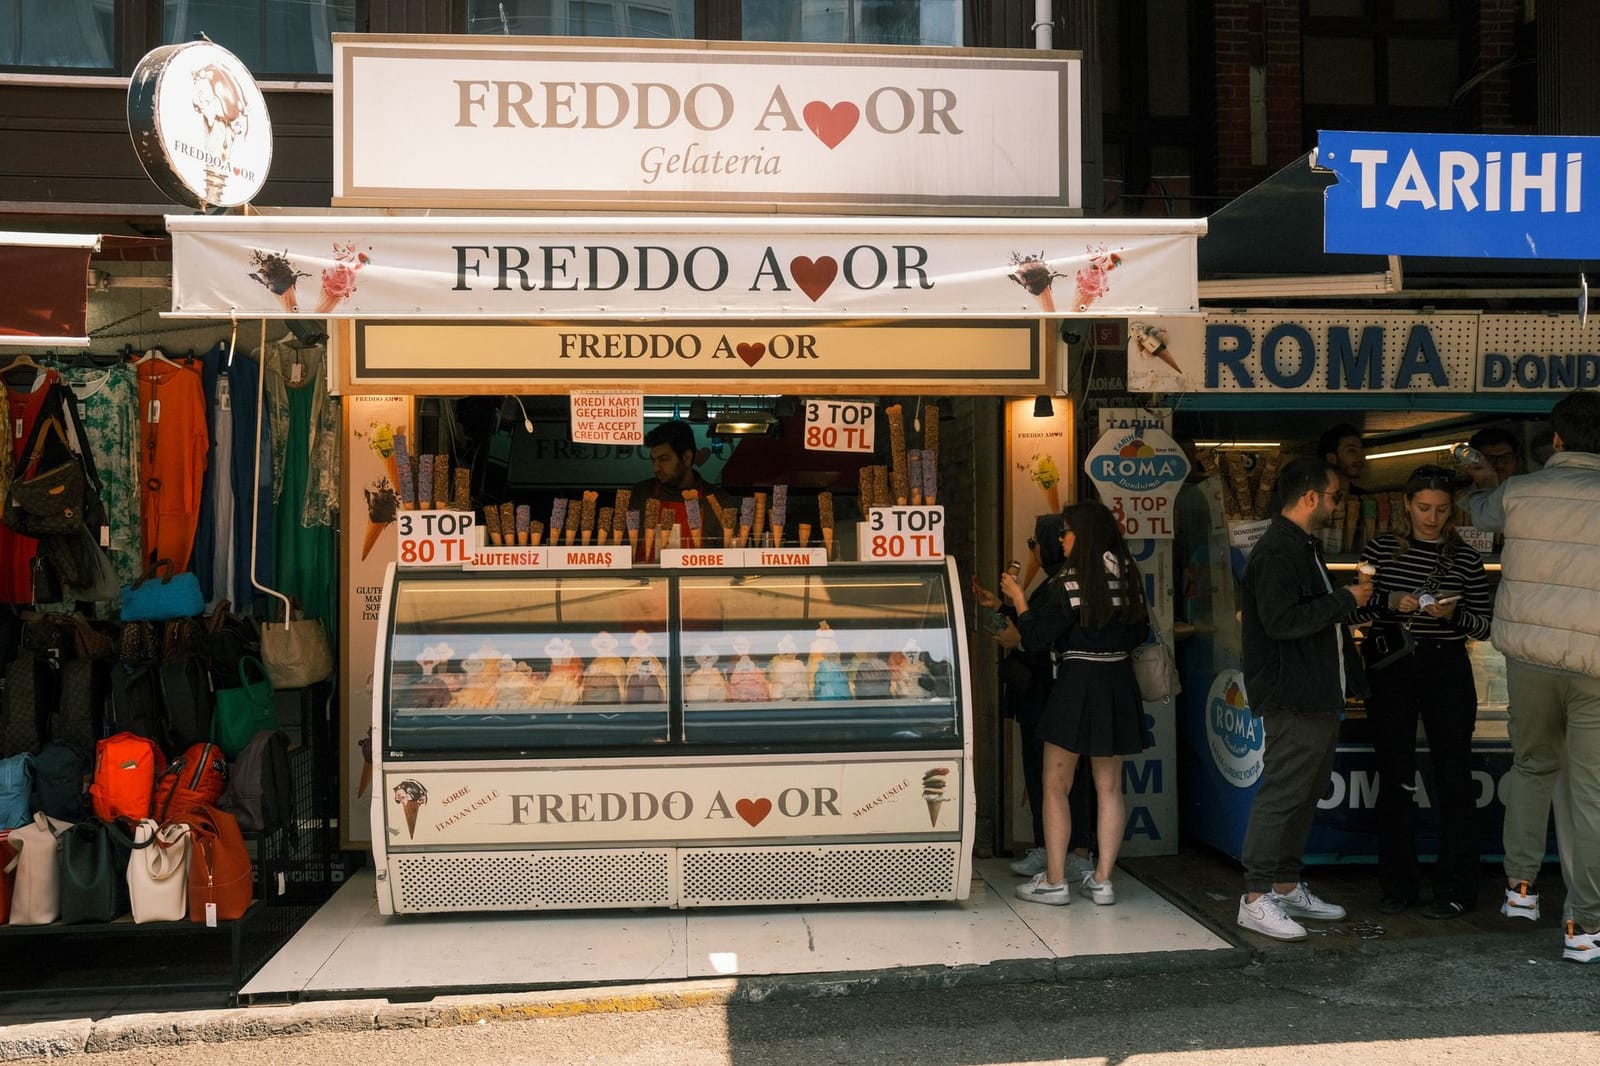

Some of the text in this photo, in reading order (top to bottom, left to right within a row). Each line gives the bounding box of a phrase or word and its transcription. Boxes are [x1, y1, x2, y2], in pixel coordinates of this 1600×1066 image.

[453, 79, 735, 131] FREDDO
[174, 139, 222, 167] FREDDO
[639, 142, 782, 184] Gelateria
[1349, 147, 1582, 213] TARİHİ
[451, 245, 729, 292] FREDDO
[558, 333, 702, 360] FREDDO
[1204, 323, 1450, 390] ROMA
[574, 396, 640, 407] KREDİ KARTI
[576, 406, 637, 420] GEÇERLİDİR
[807, 403, 872, 425] 3 TOP
[574, 430, 642, 441] CREDIT CARD
[577, 421, 637, 431] WE ACCEPT
[806, 426, 871, 449] 80 TL
[1102, 459, 1175, 477] ROMA
[1112, 496, 1167, 513] 3 TOP
[399, 514, 473, 536] 3 TOP
[871, 510, 942, 531] 3 TOP
[1147, 517, 1172, 535] TL
[401, 538, 472, 563] 80 TL
[871, 534, 941, 557] 80 TL
[471, 550, 612, 567] GLUTENSİZ MARAŞ
[681, 550, 810, 566] SORBE İTALYAN
[1216, 704, 1256, 743] ROMA
[441, 785, 471, 807] SORBE
[1315, 769, 1433, 810] OMA
[508, 789, 694, 825] FREDDO
